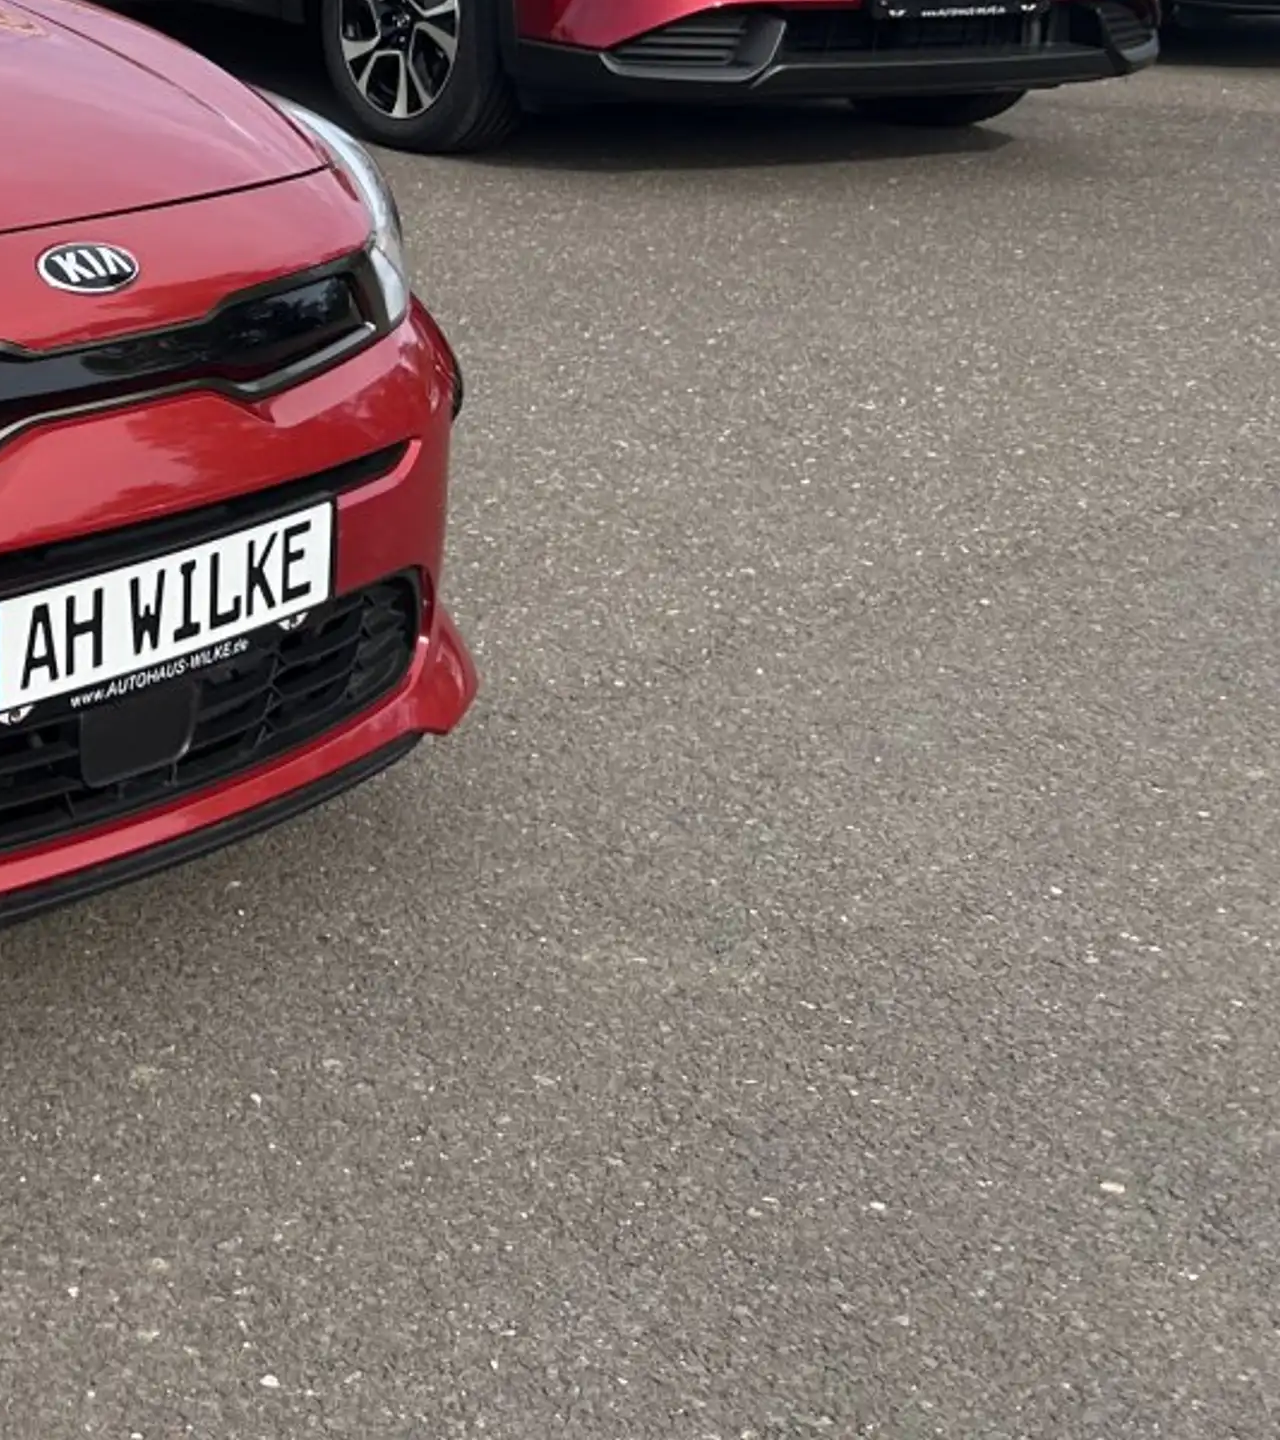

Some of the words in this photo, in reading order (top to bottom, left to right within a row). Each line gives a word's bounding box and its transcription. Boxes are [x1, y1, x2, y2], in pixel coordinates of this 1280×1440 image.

[51, 247, 132, 283] KIA
[20, 588, 104, 690] AH
[130, 521, 312, 655] WILKE
[70, 638, 250, 709] www.AUTOHAUS-WILKE.de
